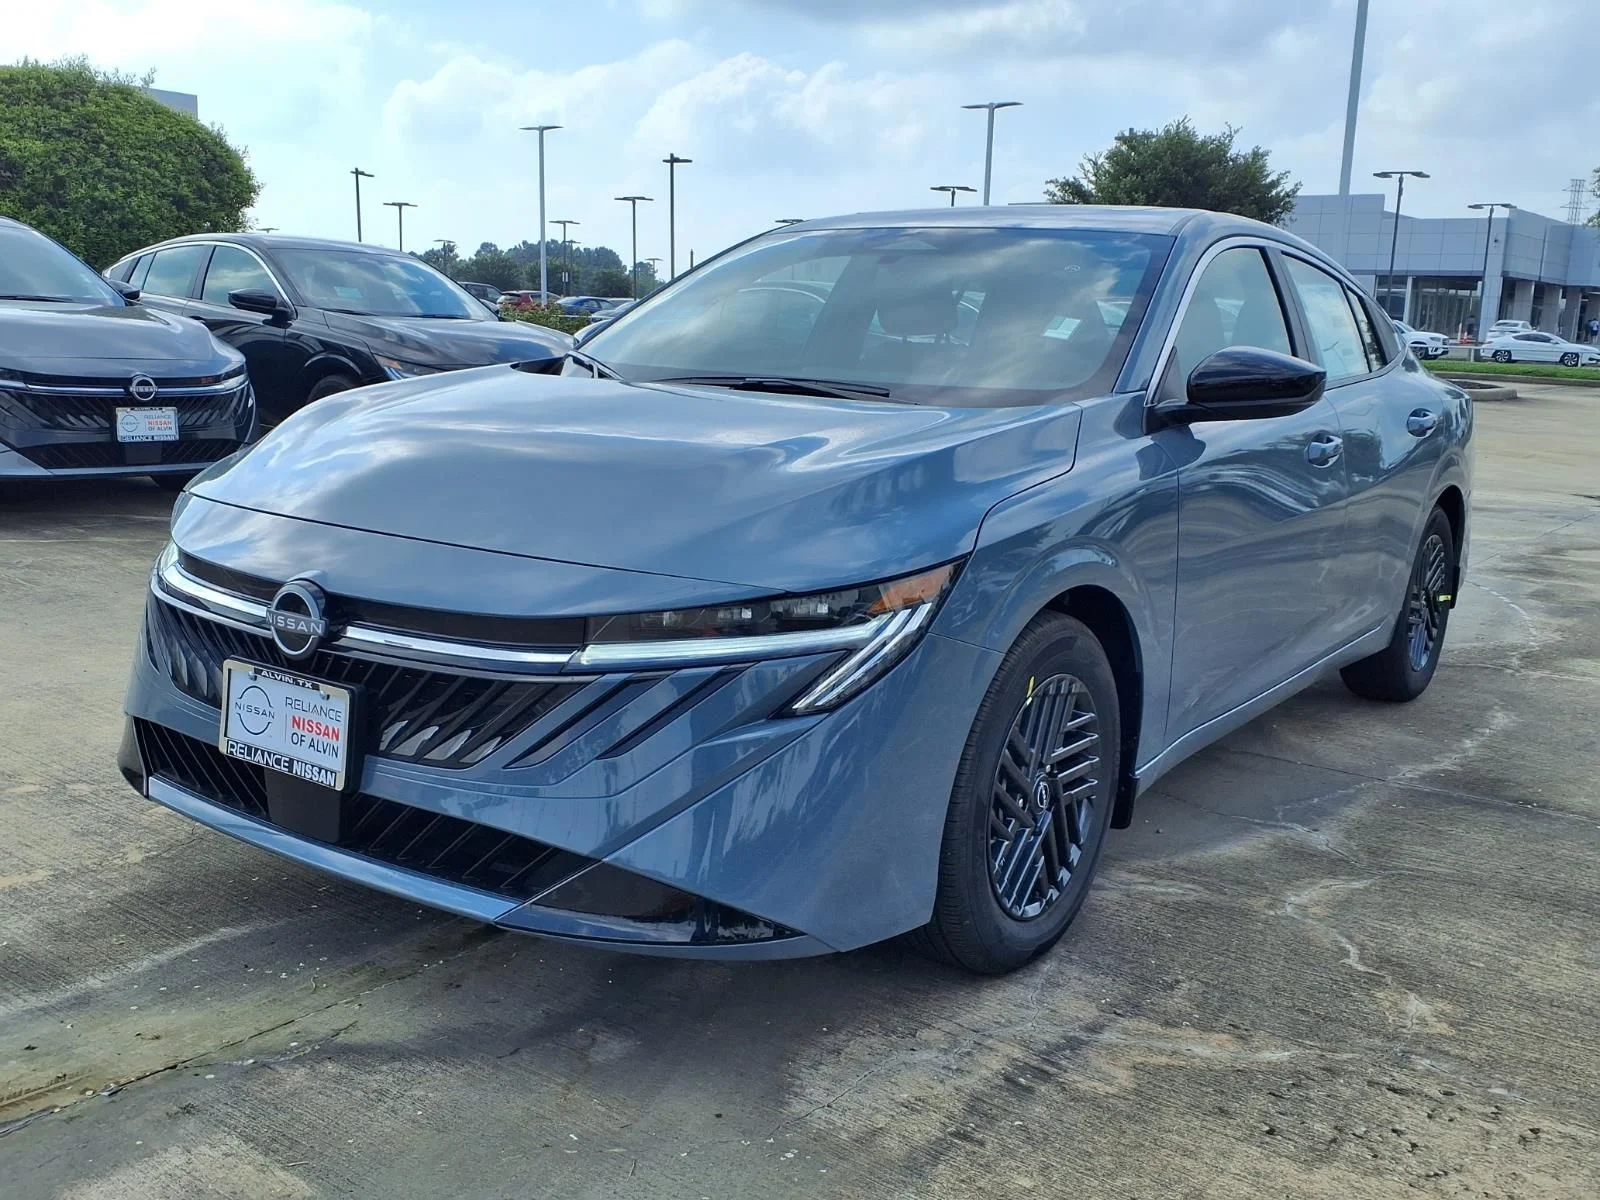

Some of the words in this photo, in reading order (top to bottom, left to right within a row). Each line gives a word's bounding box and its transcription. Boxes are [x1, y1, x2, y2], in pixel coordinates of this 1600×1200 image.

[266, 611, 322, 634] NISSAN
[299, 679, 313, 688] TX
[235, 702, 275, 719] NISSAN
[285, 696, 342, 722] RELIANCE
[292, 715, 340, 741] NISSAN
[291, 732, 306, 747] OF
[309, 738, 339, 759] ALVIN
[228, 741, 289, 771] RELIANCE
[292, 760, 336, 786] NISSAN
